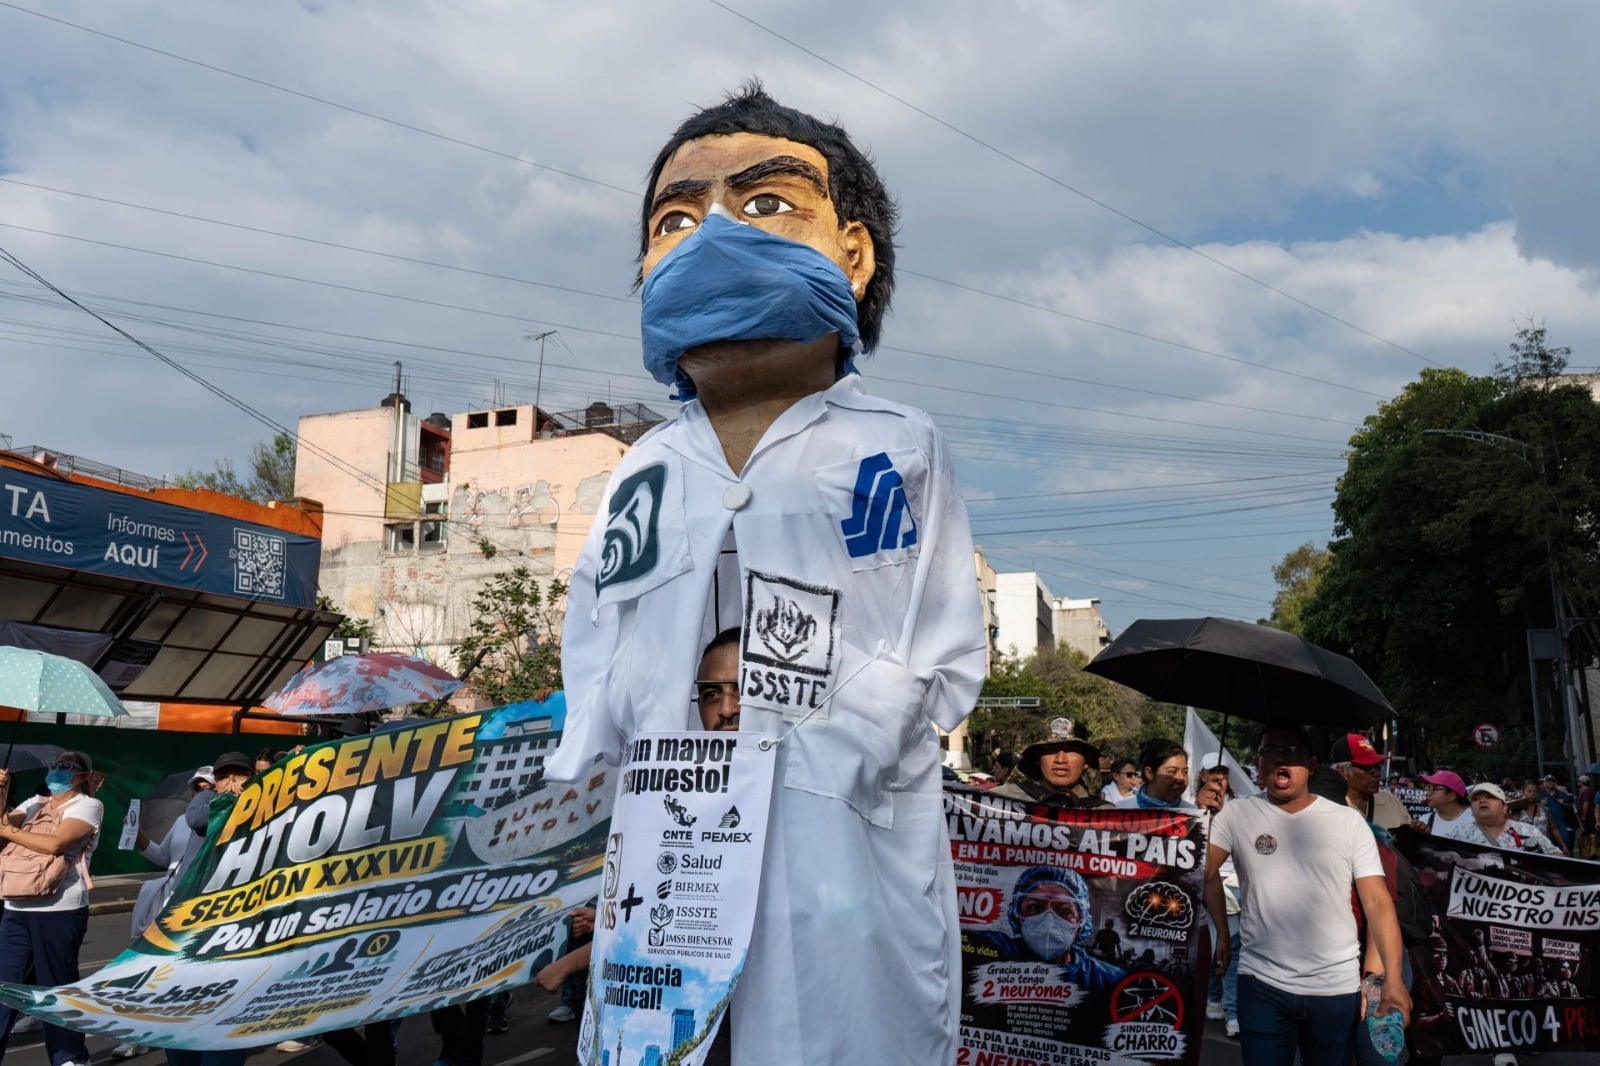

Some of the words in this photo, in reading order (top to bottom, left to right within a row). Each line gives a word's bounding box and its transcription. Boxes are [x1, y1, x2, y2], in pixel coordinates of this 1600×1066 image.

[5, 484, 51, 523] TA
[108, 512, 176, 542] Informes
[104, 541, 160, 568] AQUÍ
[656, 738, 737, 764] mayor
[216, 715, 482, 846] PRESENTE
[979, 795, 1026, 821] MIS
[1057, 809, 1188, 838] NEURONAS
[202, 768, 458, 894] HTOLV
[663, 830, 693, 841] CNTE
[701, 831, 752, 843] PEMEX
[949, 814, 1071, 850] LVAMOS
[1078, 829, 1117, 856] AL
[1127, 833, 1198, 870] PAÍS
[681, 854, 722, 869] Salud
[958, 844, 980, 859] EN
[982, 846, 1001, 860] LA
[1005, 849, 1085, 870] PANDEMIA
[1089, 857, 1138, 877] COVID
[182, 864, 313, 928] SECCIÓN
[314, 842, 434, 889] XXXVII
[675, 881, 720, 893] BIRMEX
[1454, 872, 1545, 905] ¡UNIDOS
[198, 922, 259, 955] Por
[272, 911, 304, 942] un
[302, 884, 431, 935] salario
[436, 869, 558, 916] digno
[676, 906, 718, 919] ISSSTE
[1462, 896, 1554, 925] NUESTRO
[1562, 910, 1600, 926] INS
[666, 933, 686, 944] IMSS
[687, 935, 733, 947] BIENESTAR
[1129, 923, 1138, 935] 2
[1140, 926, 1188, 941] NEURONAS
[473, 927, 555, 982] individual.
[647, 948, 676, 956] SERVICIOS
[602, 958, 683, 987] Democracia
[987, 965, 1021, 975] Gracias
[1033, 965, 1049, 975] dios
[997, 975, 1015, 985] solo
[1018, 976, 1045, 986] tengo
[150, 979, 238, 1004] base
[604, 983, 663, 1010] sindical!
[982, 980, 995, 998] 2
[1000, 984, 1072, 999] neuronas
[1120, 1024, 1169, 1033] SINDICATO
[1458, 1006, 1537, 1050] GINECO
[1542, 1005, 1560, 1042] 4
[973, 1029, 982, 1039] A
[984, 1030, 1002, 1042] DÍA
[1005, 1036, 1019, 1046] LA
[1022, 1039, 1057, 1054] SALUD
[1061, 1045, 1082, 1057] DEL
[1084, 1047, 1111, 1061] PAÍS
[991, 1042, 1005, 1053] EN
[1007, 1047, 1050, 1062] MANOS
[1053, 1054, 1067, 1065] DE
[1113, 1034, 1178, 1051] CHARRO
